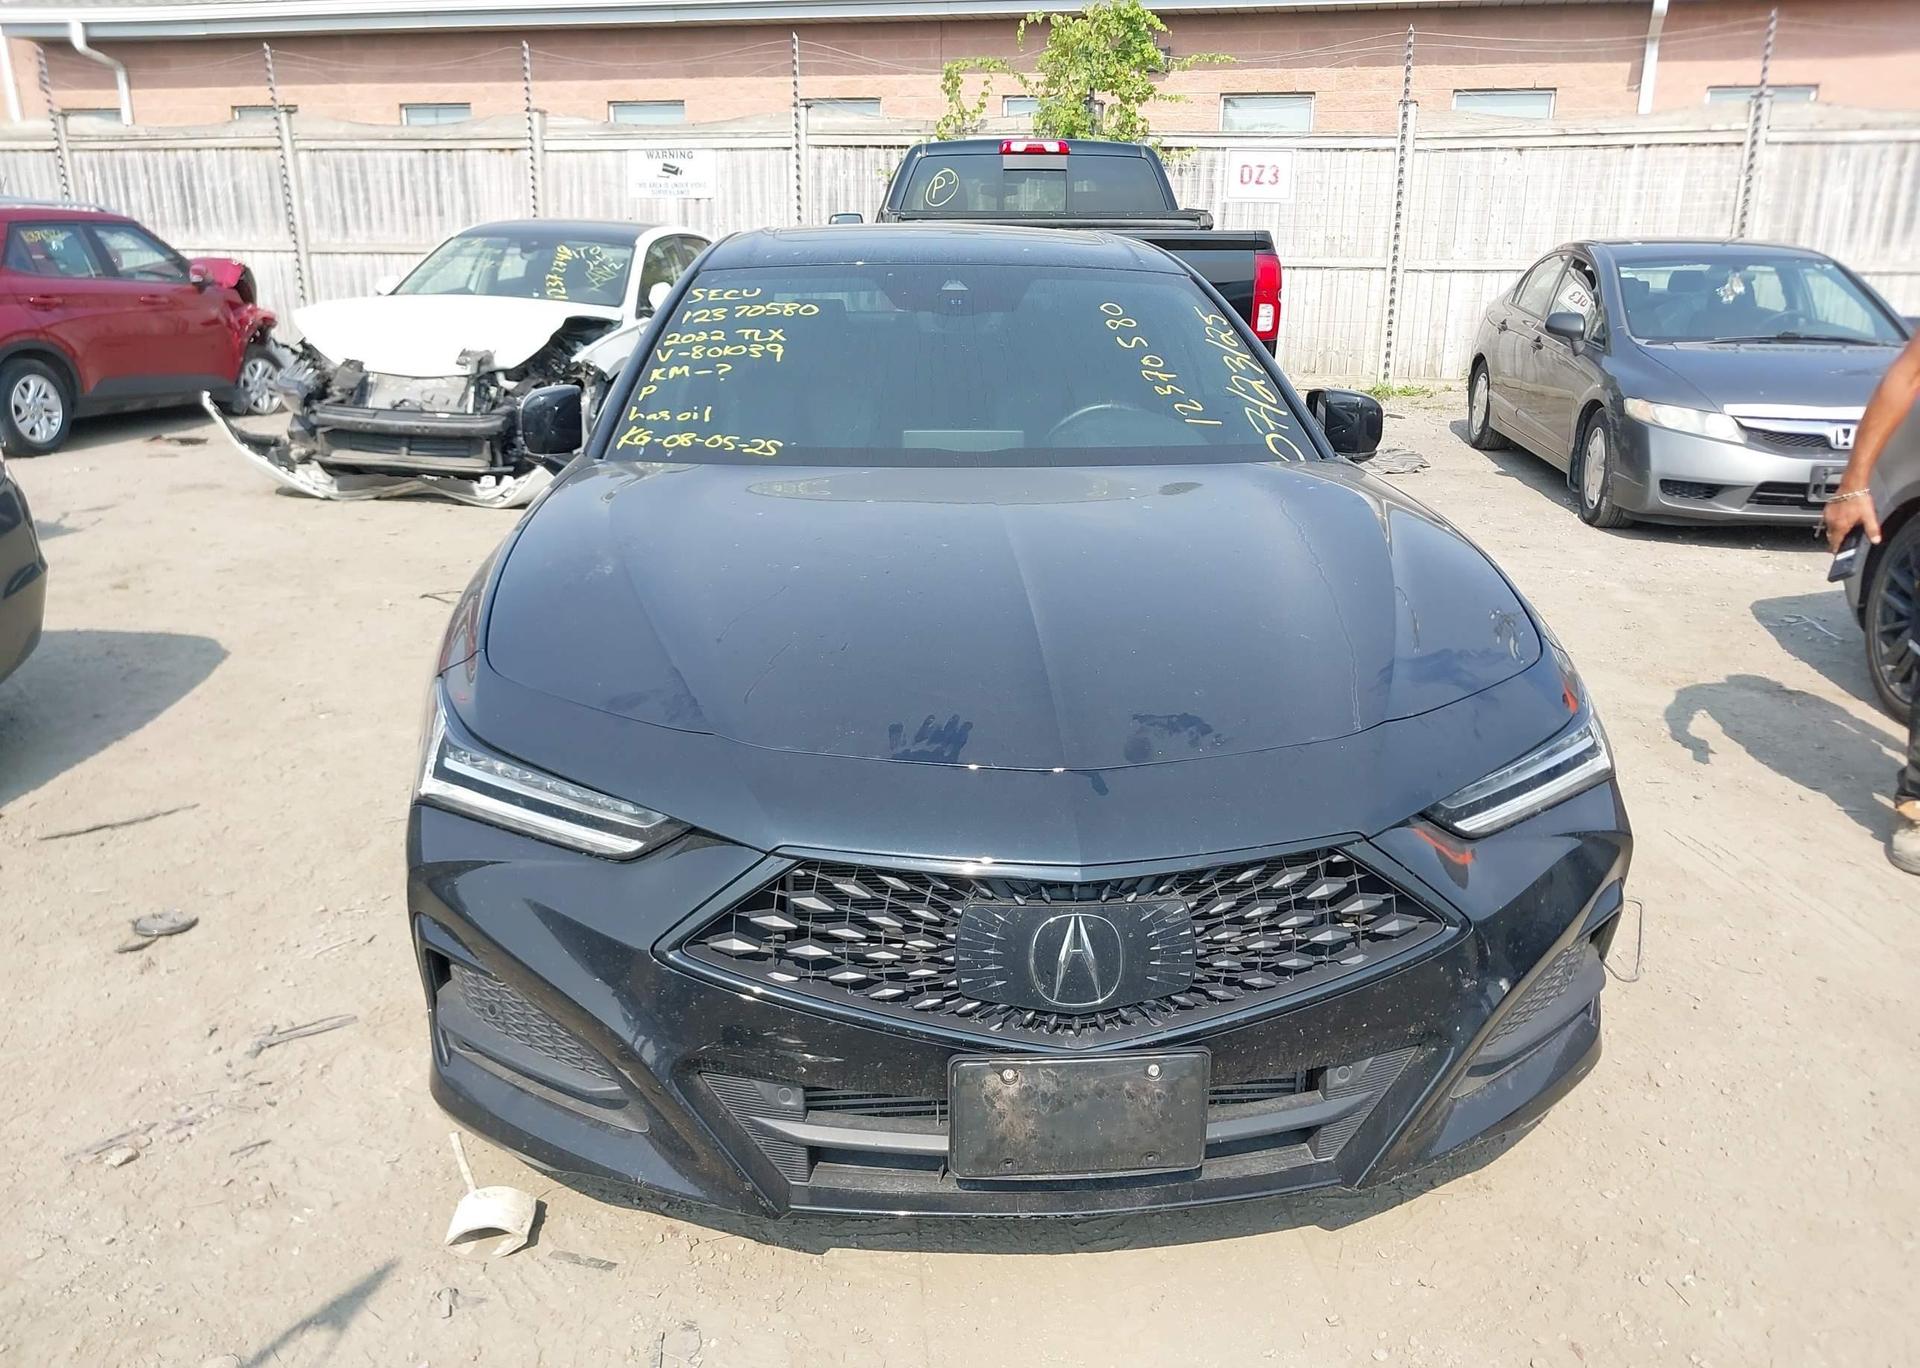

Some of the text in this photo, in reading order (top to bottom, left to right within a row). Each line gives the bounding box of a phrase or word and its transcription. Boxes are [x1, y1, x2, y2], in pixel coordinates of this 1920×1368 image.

[646, 151, 694, 159] WARNING
[688, 288, 762, 304] SECU
[663, 328, 787, 346] 2022 TLX
[638, 385, 658, 401] P
[628, 406, 712, 423] has oil
